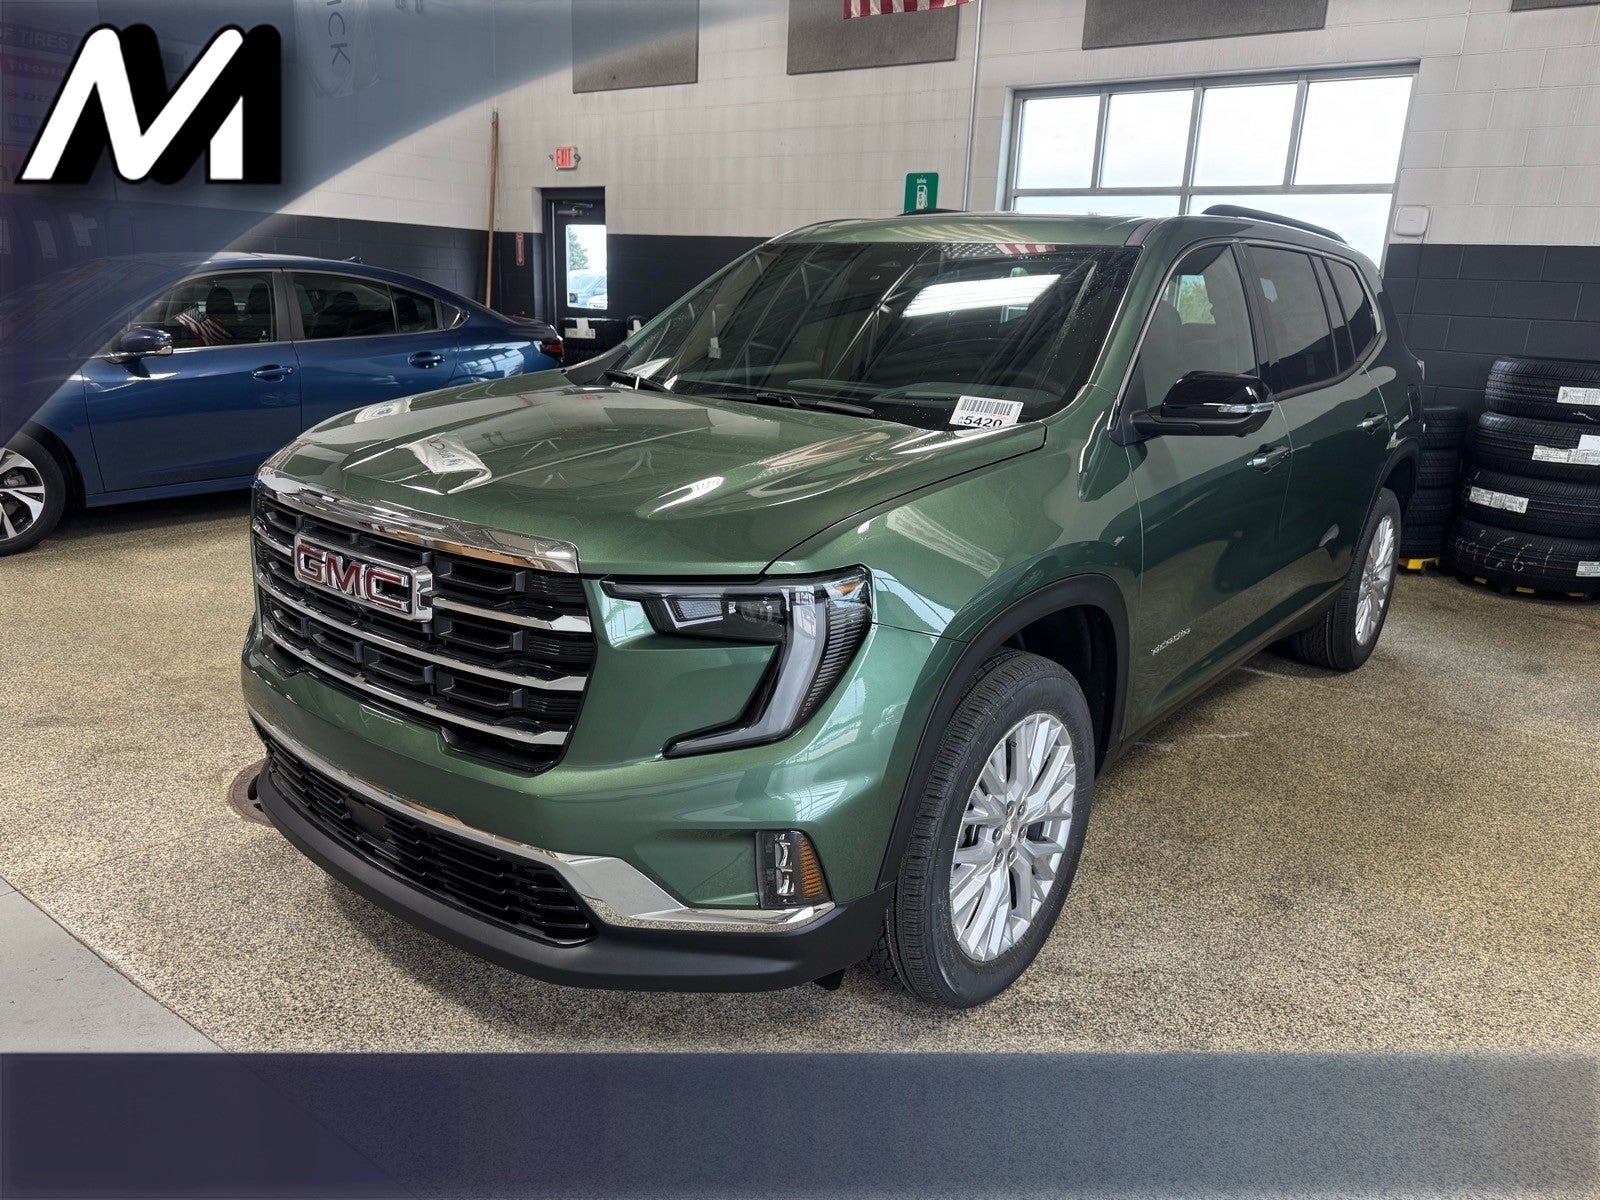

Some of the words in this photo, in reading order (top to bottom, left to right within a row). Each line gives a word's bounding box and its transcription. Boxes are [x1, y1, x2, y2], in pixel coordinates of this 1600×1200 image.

[18, 31, 69, 50] TIRES
[556, 148, 571, 166] EXIT
[296, 544, 410, 613] GMC
